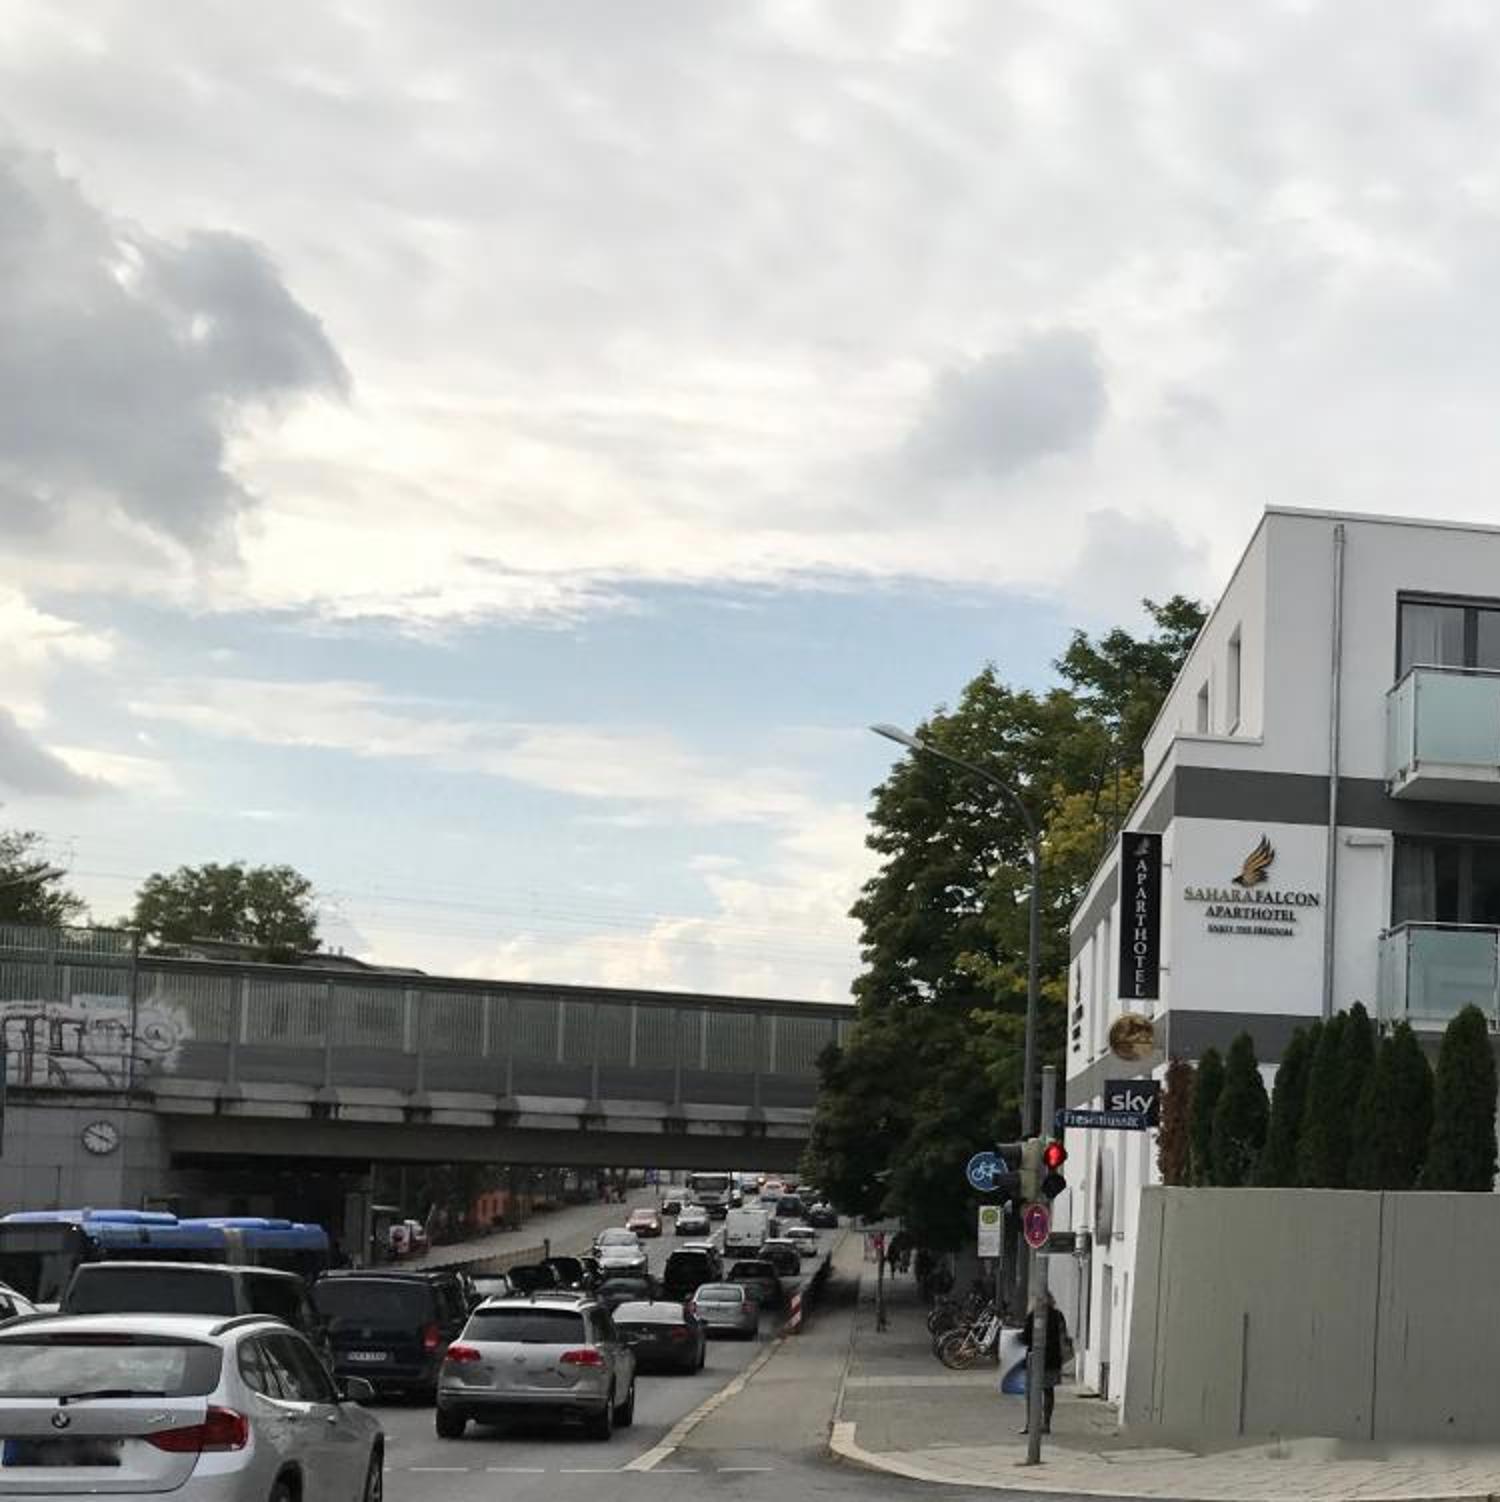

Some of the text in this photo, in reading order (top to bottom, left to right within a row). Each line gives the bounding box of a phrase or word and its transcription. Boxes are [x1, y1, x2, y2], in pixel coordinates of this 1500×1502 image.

[1205, 905, 1297, 922] APARTHOTEL
[1133, 859, 1148, 997] APARTHOTEL
[1111, 1089, 1154, 1114] sky
